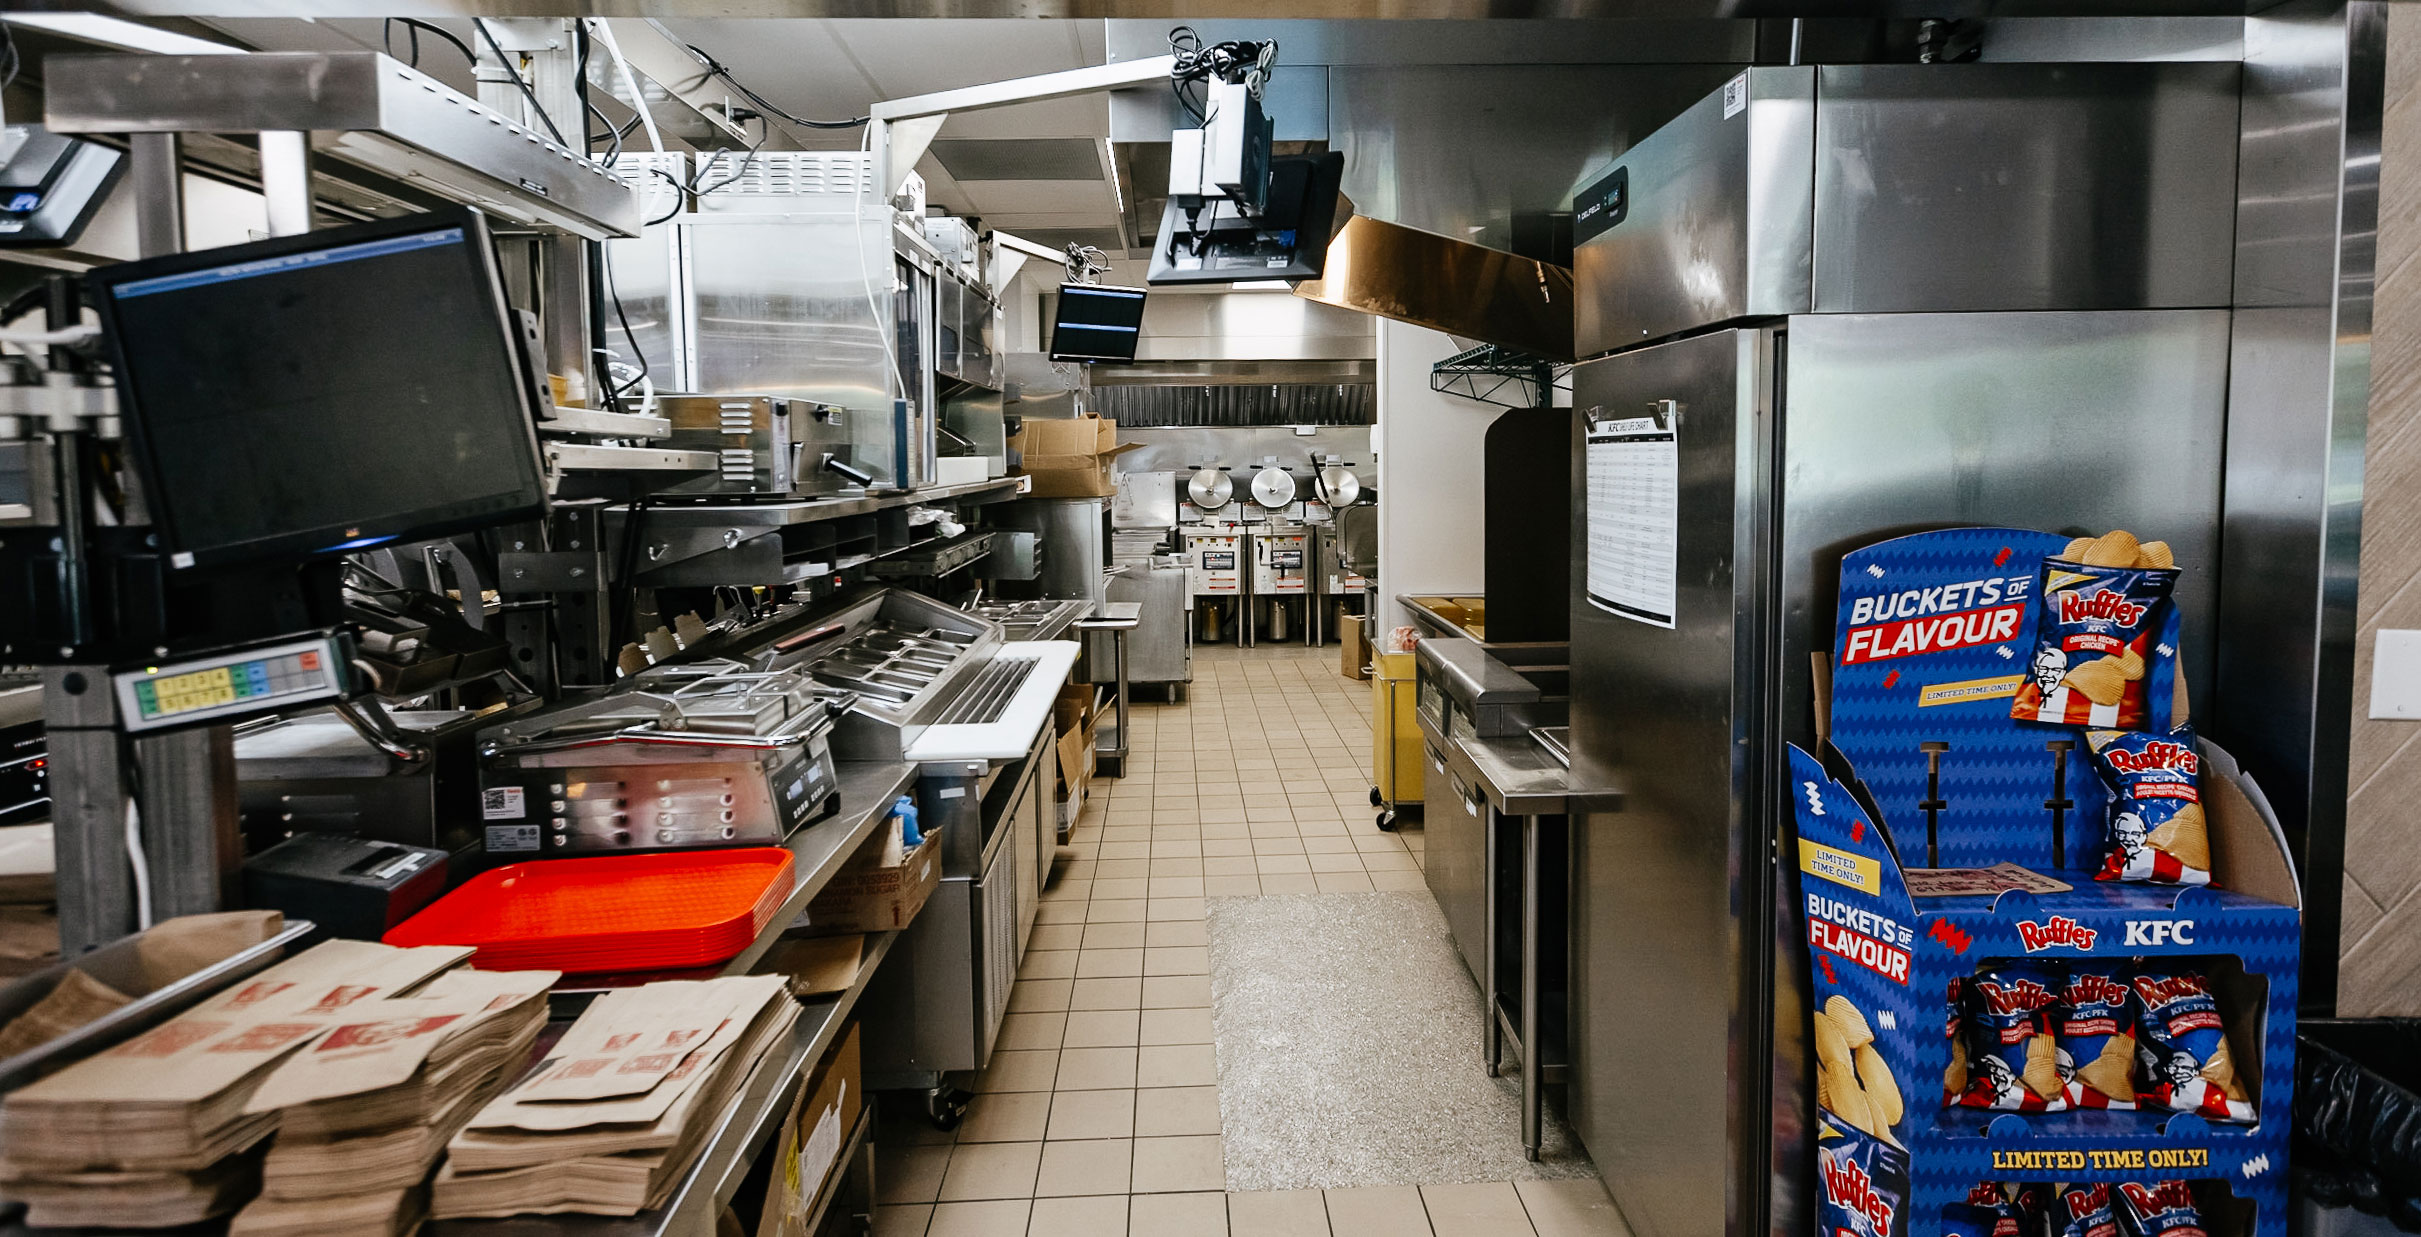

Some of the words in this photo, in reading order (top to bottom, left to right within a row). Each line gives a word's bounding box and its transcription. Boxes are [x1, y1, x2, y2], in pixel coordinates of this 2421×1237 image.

[1850, 577, 2005, 625] BUCKETS
[2007, 580, 2030, 596] OF
[2058, 588, 2148, 628] Ruffles
[1846, 608, 2018, 662] FLAVOUR
[2086, 625, 2107, 633] KFC
[1927, 688, 1964, 700] LIMITED
[1967, 685, 1988, 695] TIME
[1990, 683, 2017, 693] ONLY!
[2103, 741, 2198, 775] Ruffles
[1811, 860, 1834, 875] TIME
[1836, 868, 1864, 885] ONLY!
[1816, 849, 1856, 869] LIMITED
[1808, 893, 1897, 943] BUCKETS
[1898, 930, 1913, 945] OF
[2016, 915, 2097, 953] Ruffles
[2124, 919, 2194, 946] KFC
[1811, 919, 1907, 981] FLAVOUR
[1993, 1151, 2085, 1169] LIMITED
[2089, 1150, 2145, 1169] TIME
[2149, 1149, 2208, 1167] ONLY!
[1819, 1146, 1894, 1237] Ruffles
